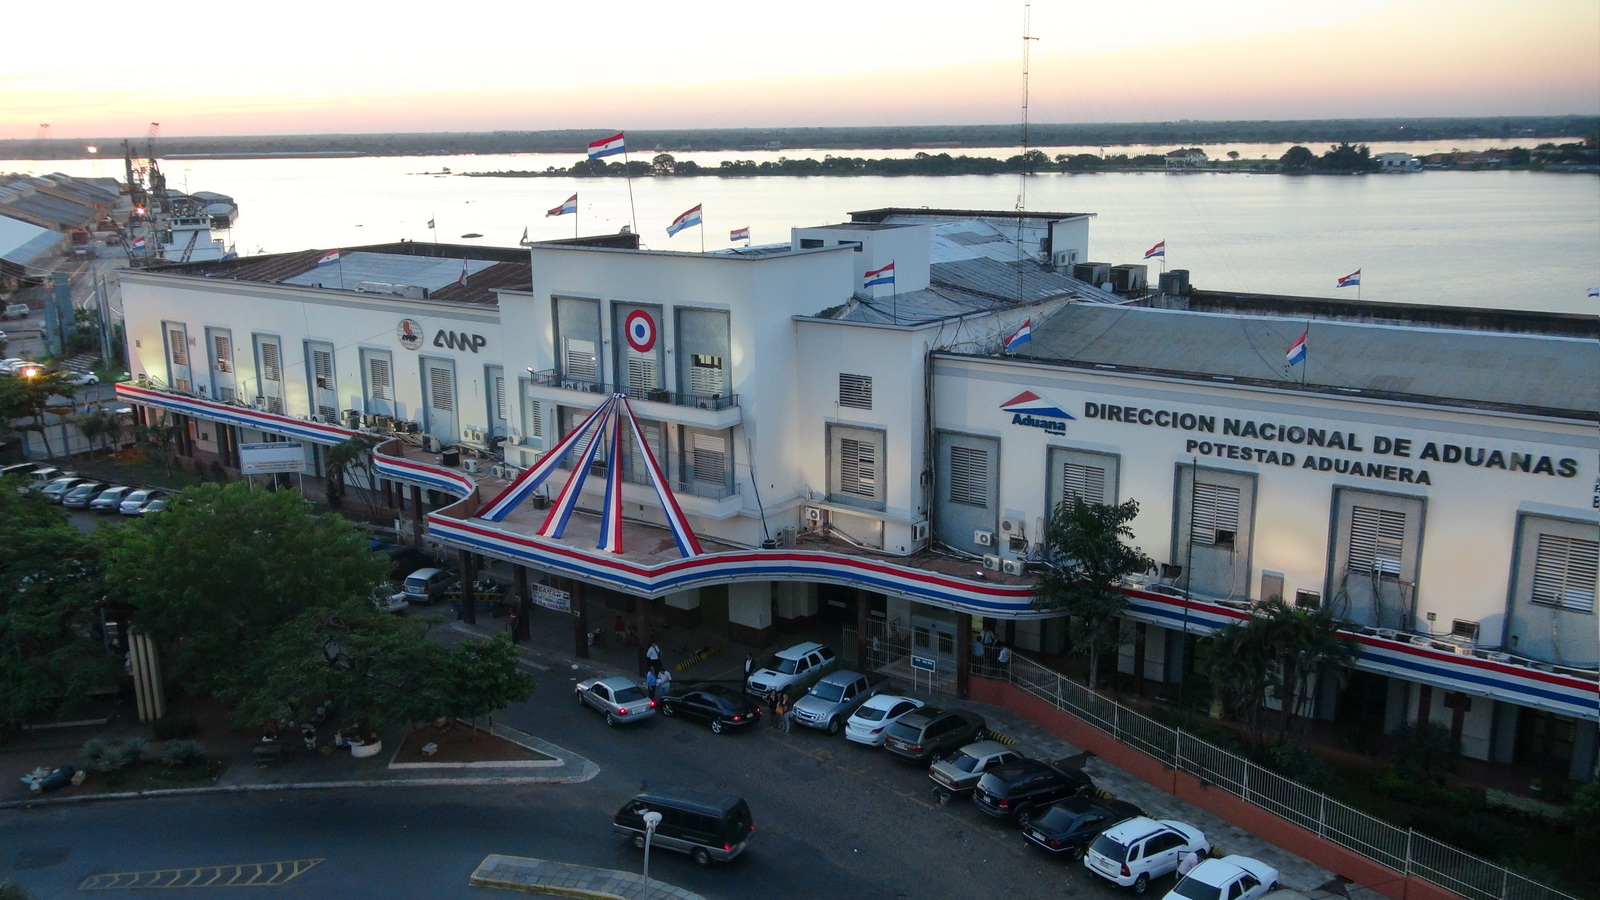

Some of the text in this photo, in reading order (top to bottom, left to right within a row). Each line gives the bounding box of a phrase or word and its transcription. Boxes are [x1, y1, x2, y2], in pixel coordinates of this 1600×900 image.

[1012, 413, 1066, 431] Aduana
[1084, 402, 1578, 478] DIRECCION NACIONAL DE ADUANAS
[1186, 439, 1431, 485] POTESTAD ADUANERA
